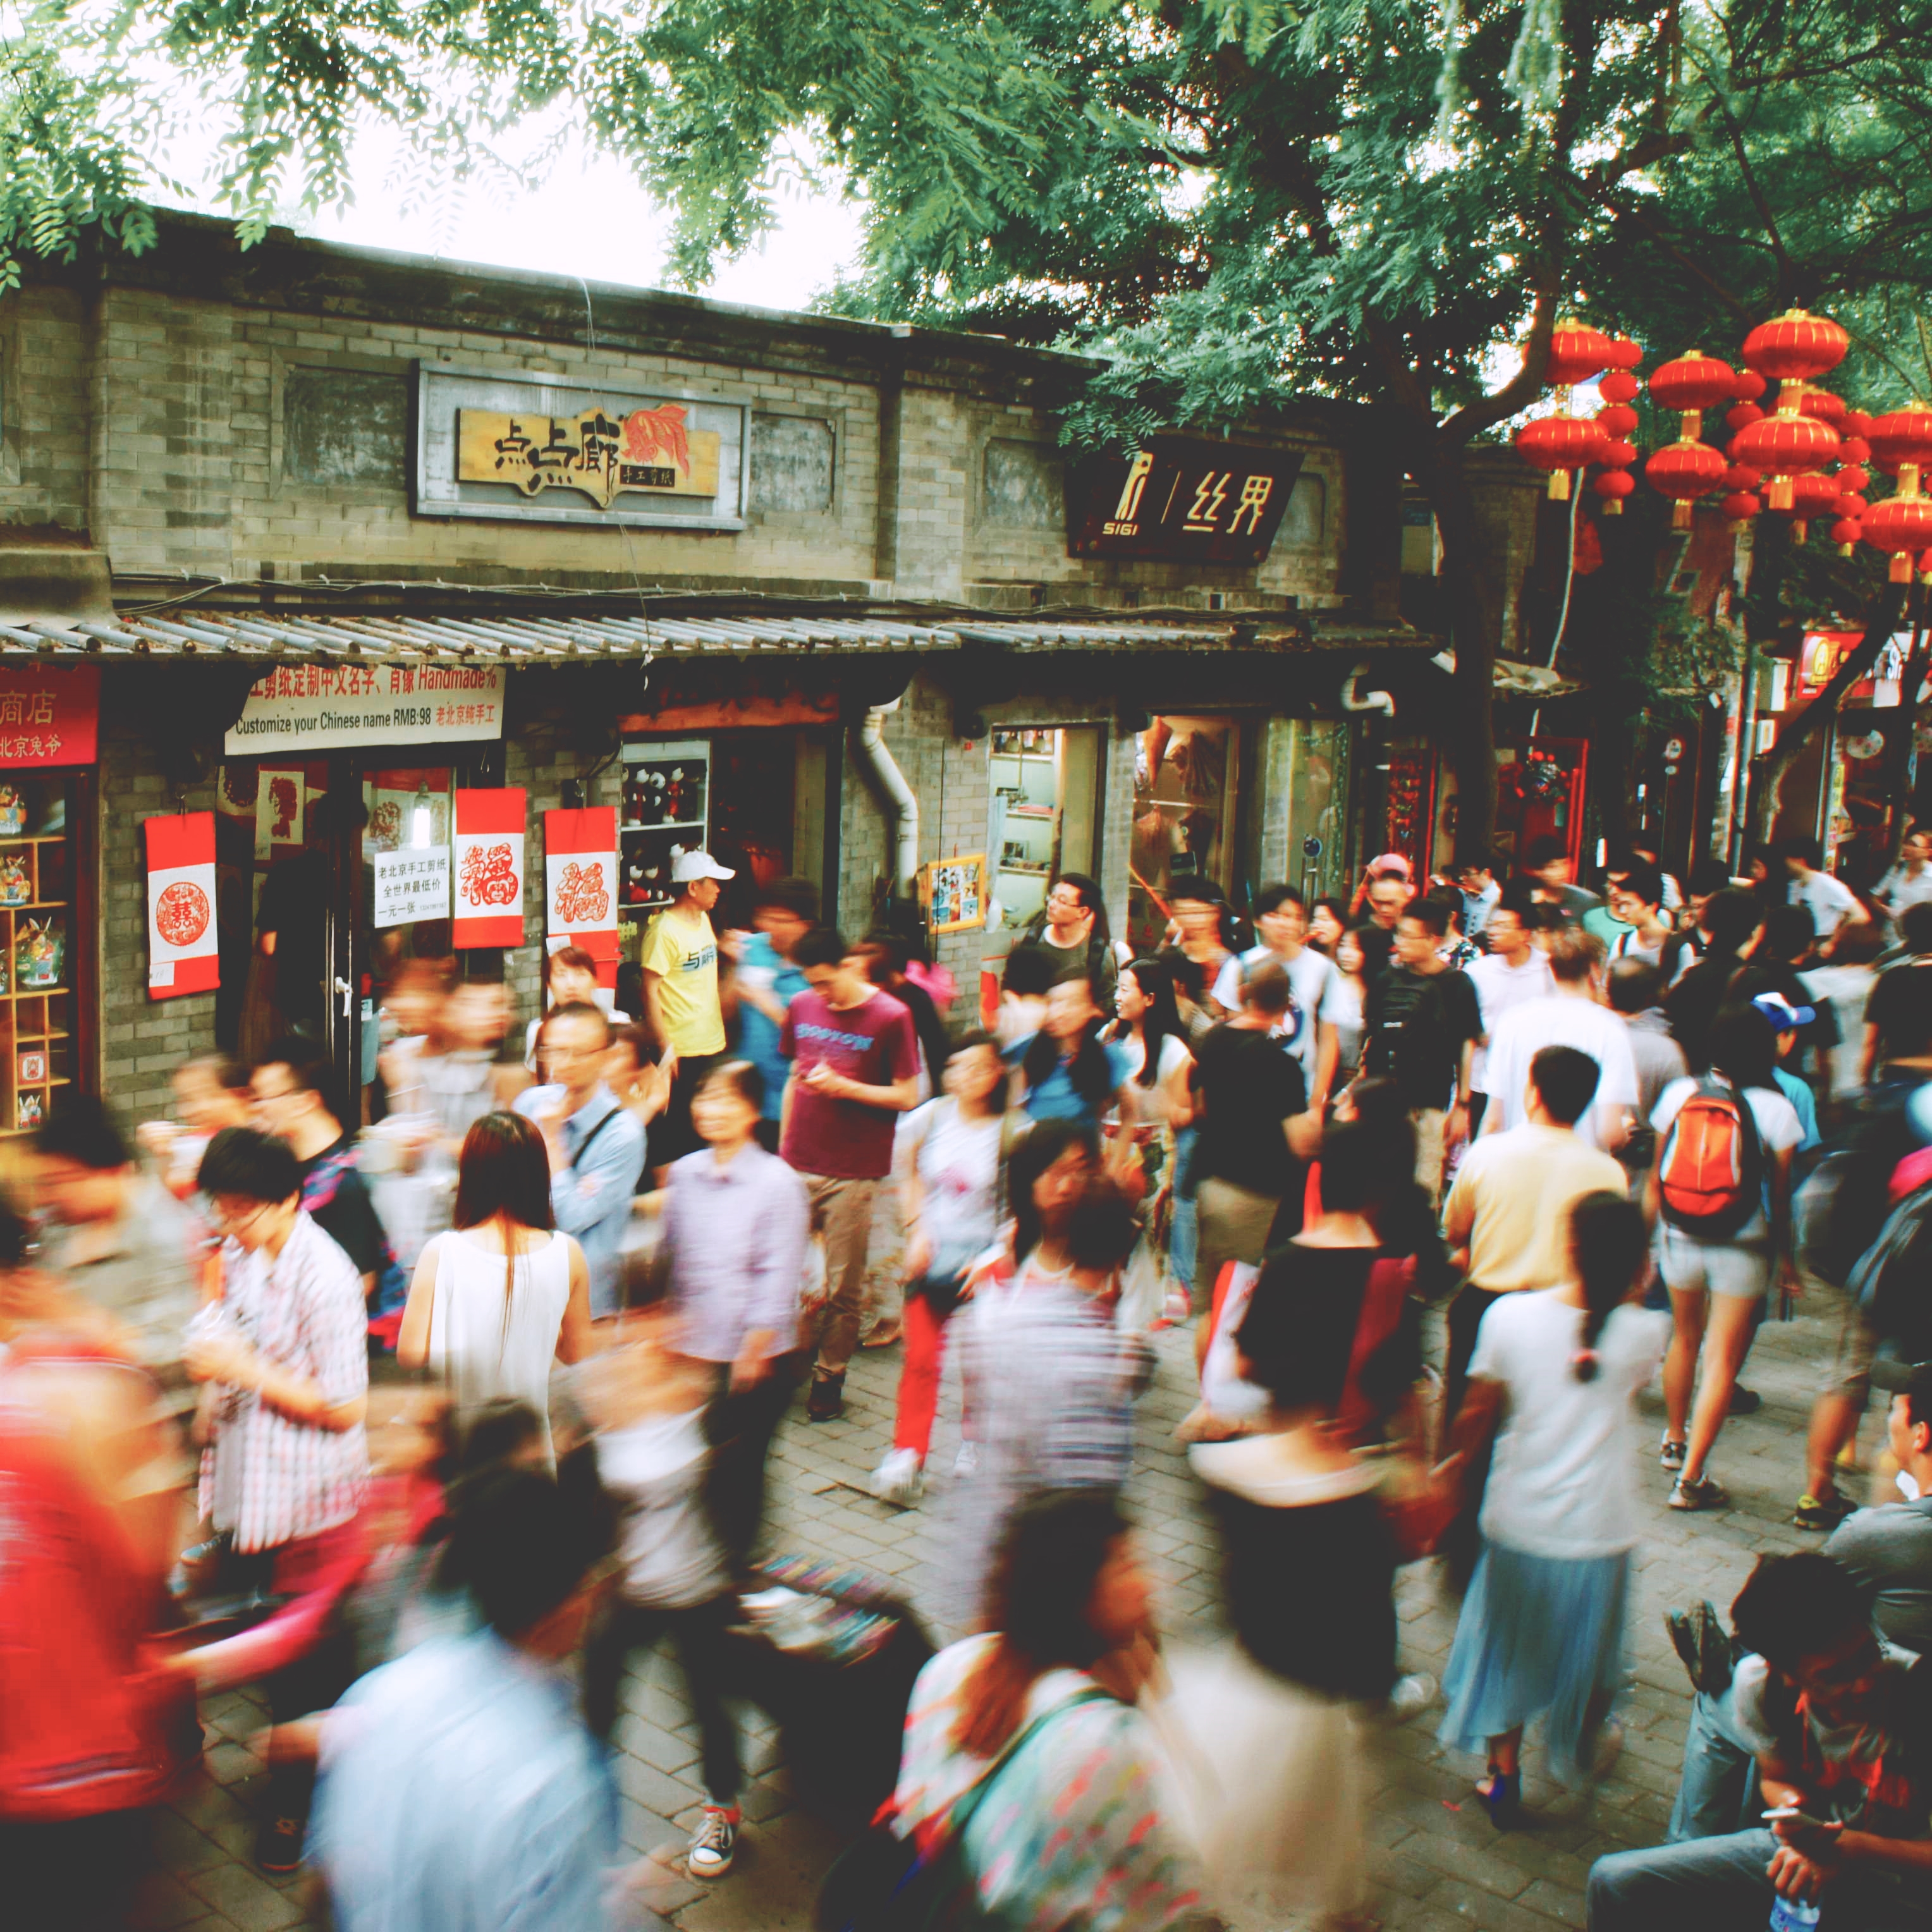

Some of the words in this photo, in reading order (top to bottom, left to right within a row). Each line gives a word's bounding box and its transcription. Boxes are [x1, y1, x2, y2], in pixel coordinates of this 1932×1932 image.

[0, 688, 57, 726] 商店
[235, 714, 291, 735] Customize
[294, 718, 318, 736] your
[321, 711, 361, 730] Chinese
[364, 713, 391, 728] name
[393, 707, 432, 726] RMB:98
[0, 733, 61, 758] 北京兔爷
[379, 858, 447, 879] 老北京手工剪纸
[384, 877, 441, 898] 全世界最低价
[378, 900, 415, 917] 一元一张
